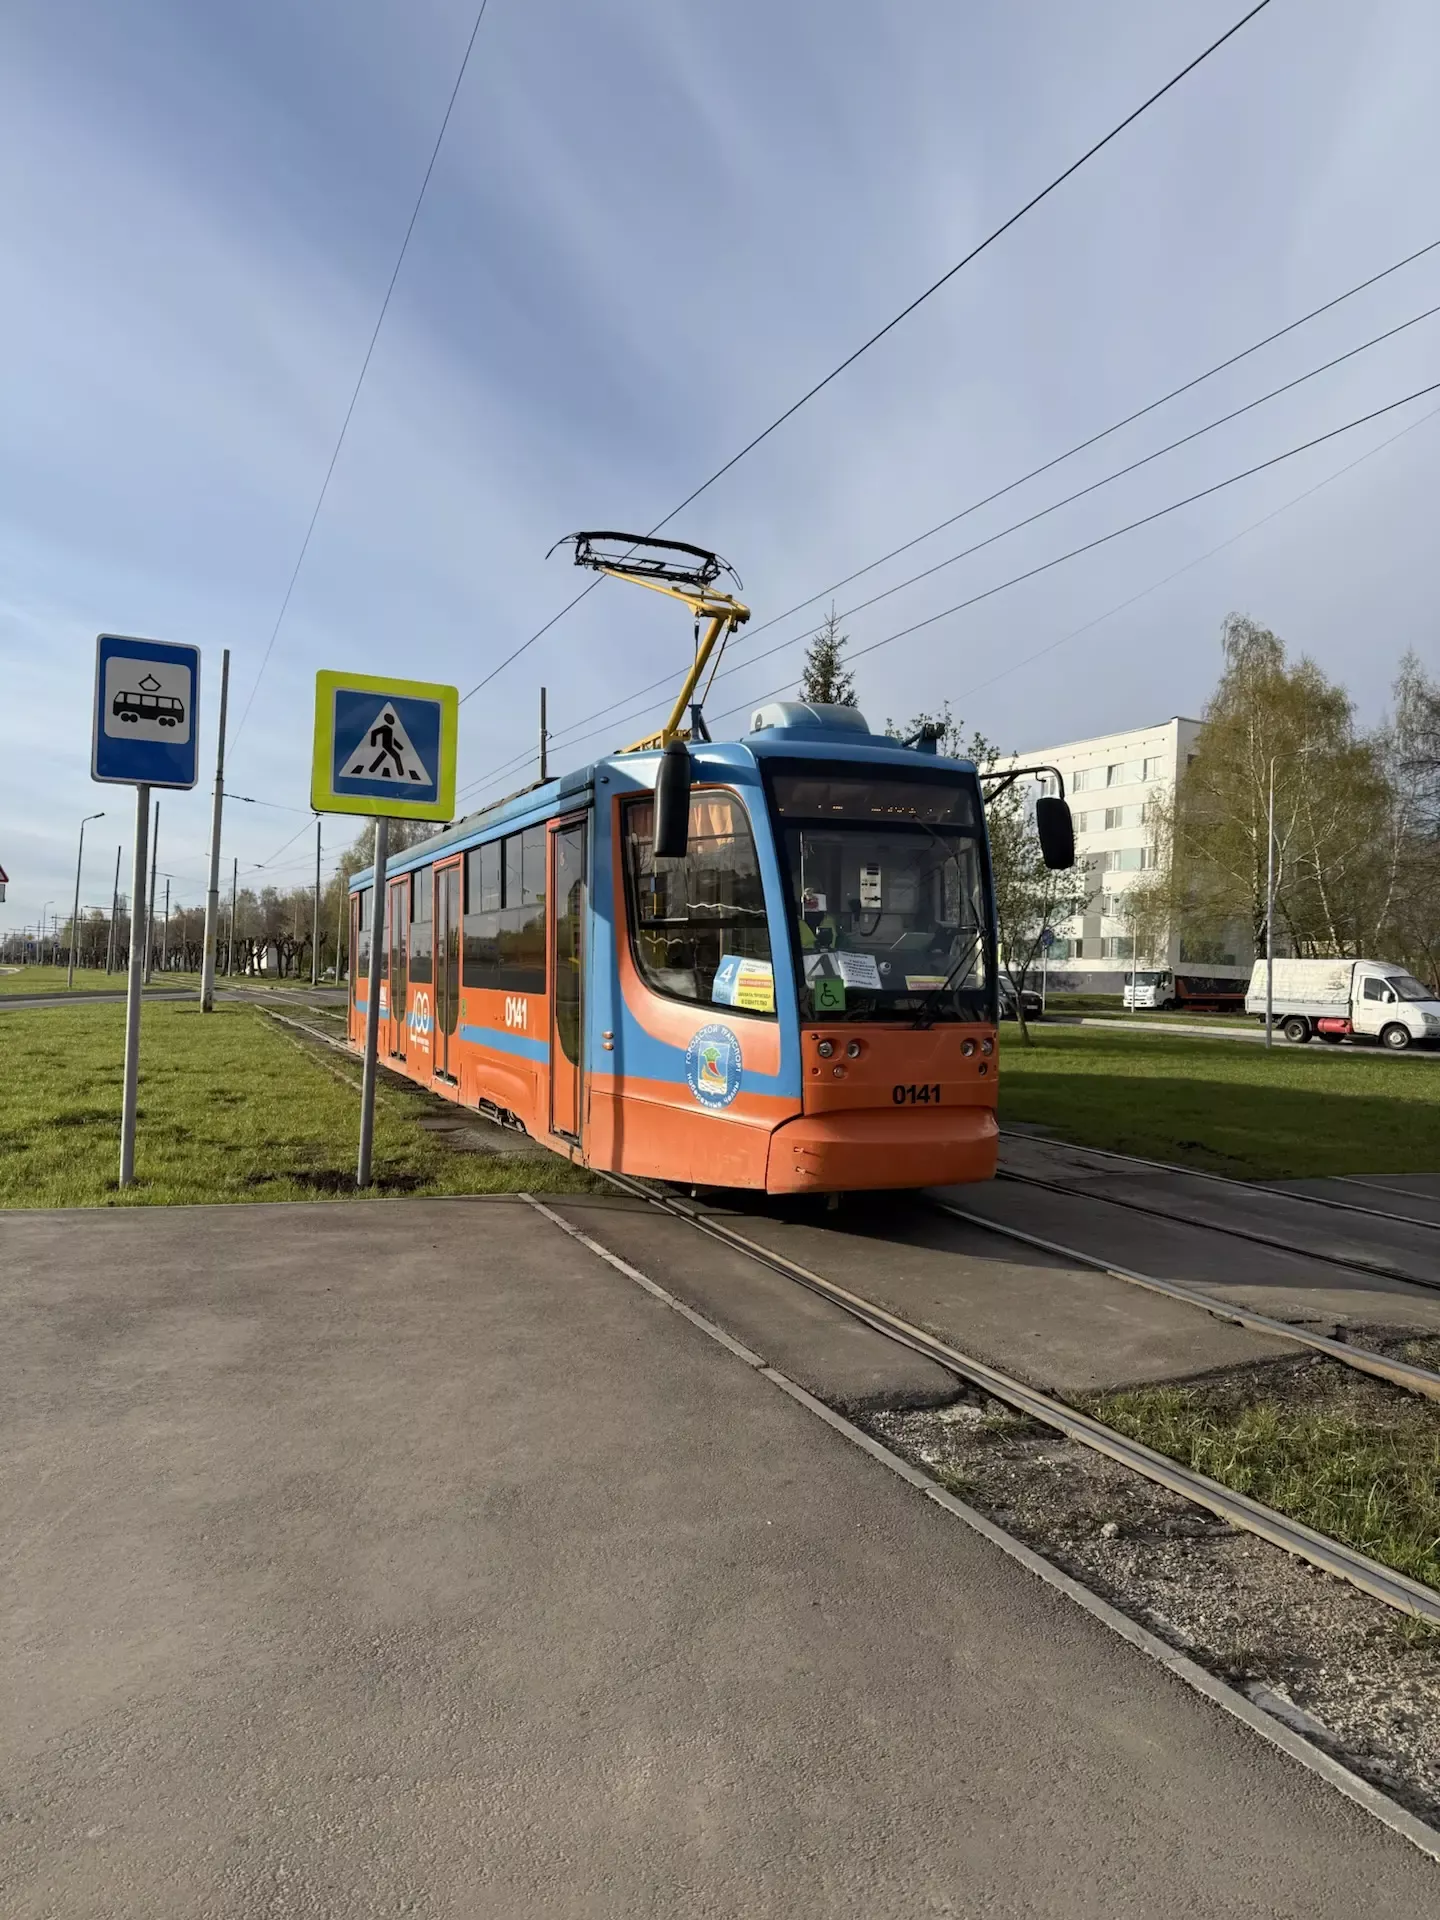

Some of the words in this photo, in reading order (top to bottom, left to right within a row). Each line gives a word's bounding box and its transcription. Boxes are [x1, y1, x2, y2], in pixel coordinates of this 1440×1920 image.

[719, 963, 735, 983] 4
[505, 995, 528, 1030] 0141
[685, 1026, 718, 1064] ГОРОДСКОЙ
[721, 1027, 741, 1072] ТРАНСПОРТ
[892, 1084, 941, 1105] 0141
